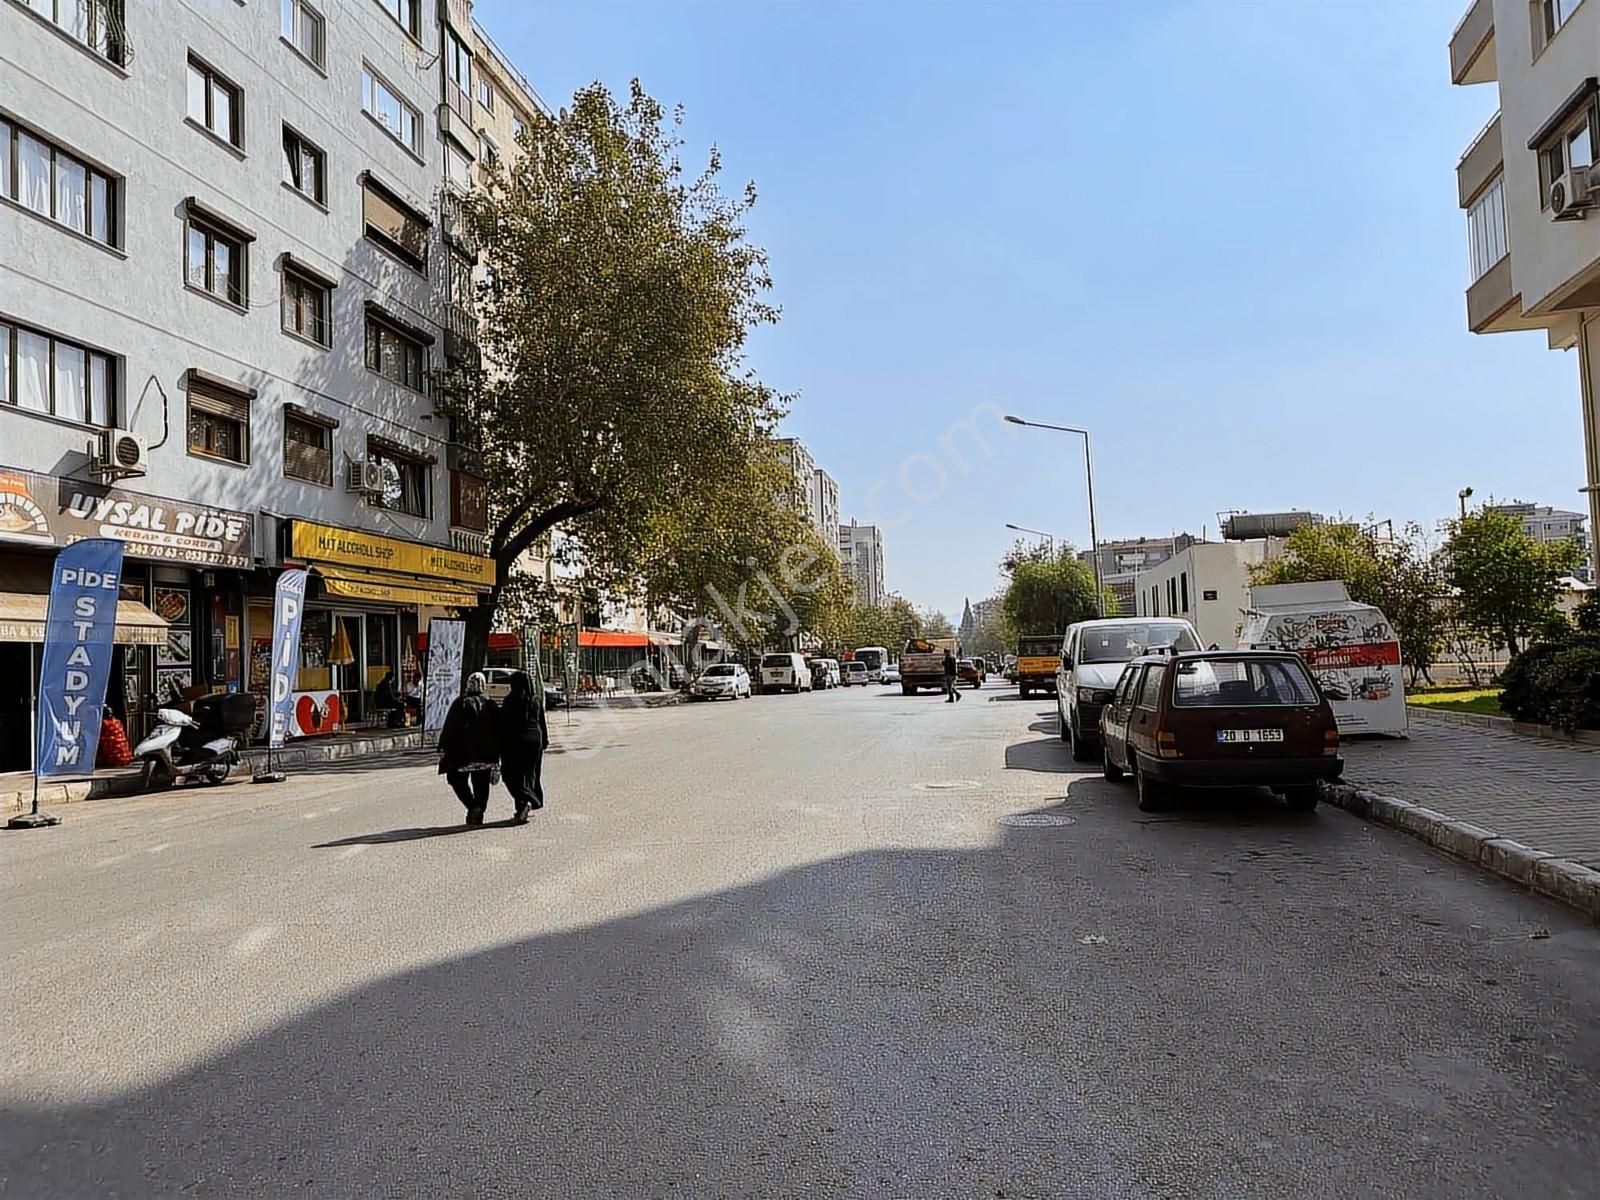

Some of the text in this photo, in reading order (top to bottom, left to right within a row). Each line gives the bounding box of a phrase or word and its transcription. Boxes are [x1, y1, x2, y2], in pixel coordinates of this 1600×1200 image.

[69, 493, 243, 542] UYSAL PİDE
[61, 566, 117, 590] PİDE
[55, 595, 97, 767] STADYUM
